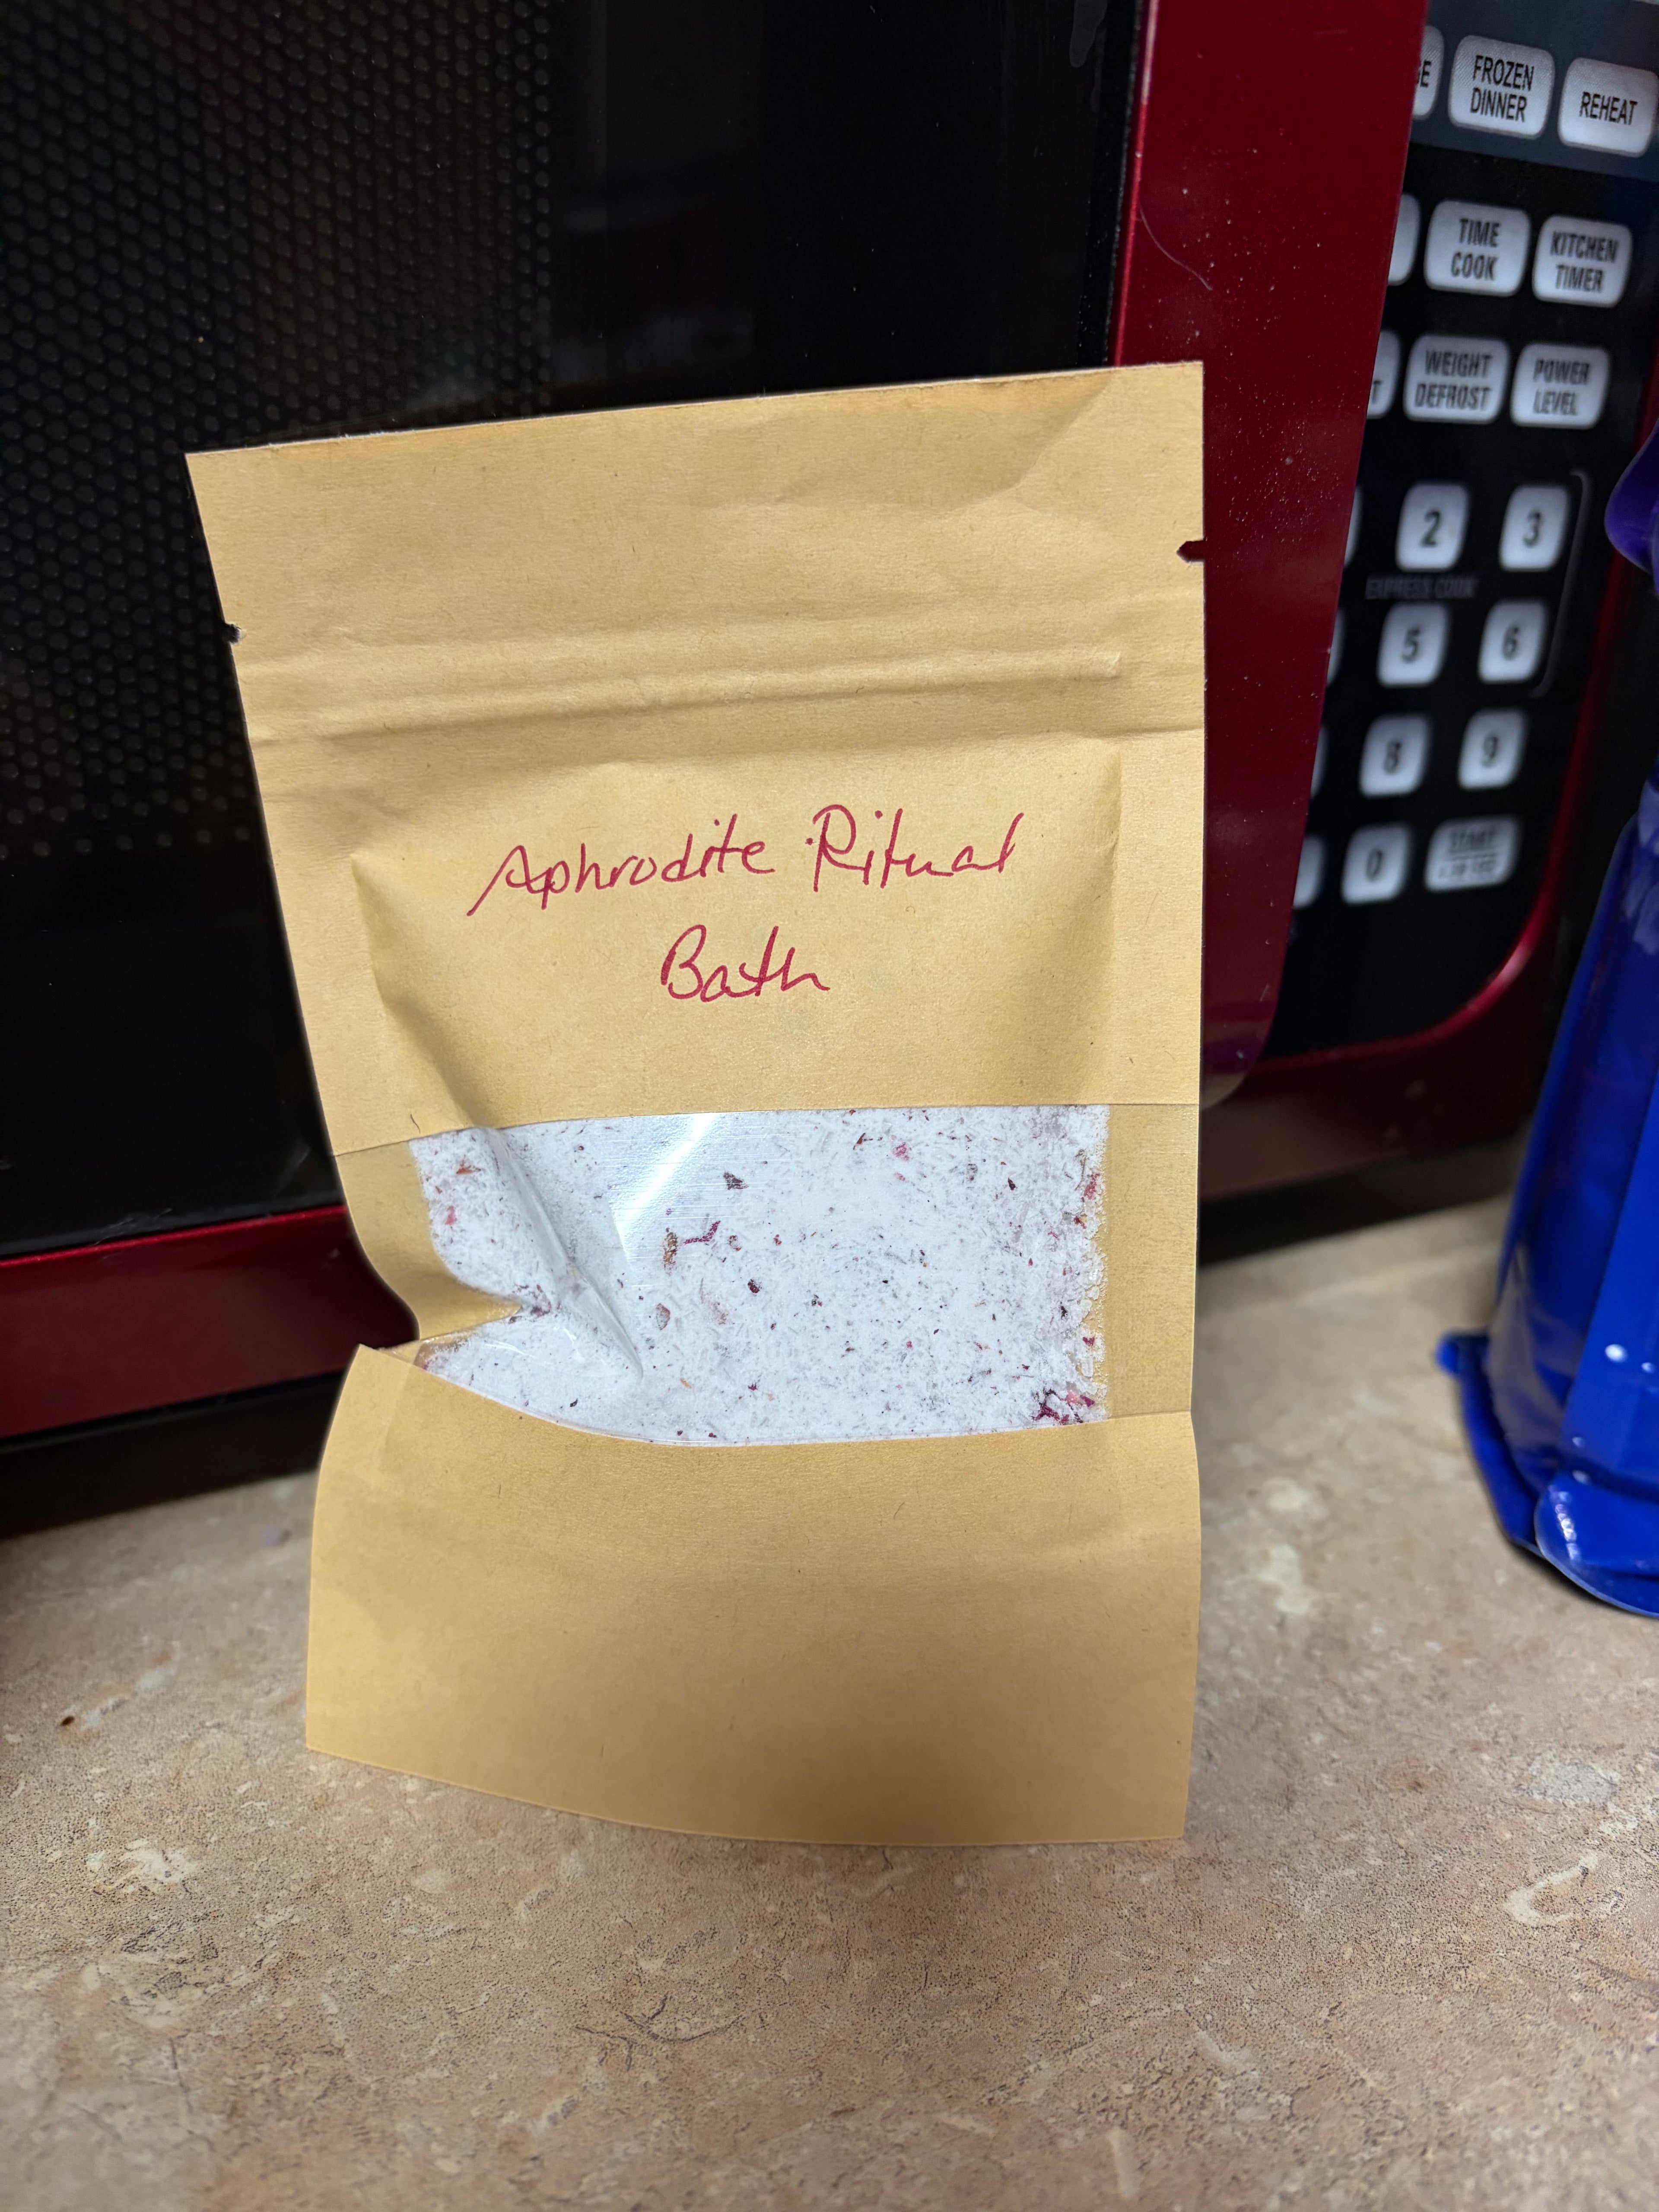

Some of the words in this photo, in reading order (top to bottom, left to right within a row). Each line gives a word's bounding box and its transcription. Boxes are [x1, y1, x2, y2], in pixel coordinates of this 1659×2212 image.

[1472, 55, 1534, 92] FROZEN
[1470, 87, 1527, 123] DINNER
[1579, 91, 1638, 125] REHEAT
[1459, 217, 1501, 248] TIME
[1550, 231, 1620, 263] KITCHEN
[1450, 251, 1498, 281] COOK
[1555, 264, 1604, 292] TIMER
[1424, 350, 1494, 378] WEIGHT
[1532, 358, 1591, 385] POWER
[1414, 382, 1493, 410] DEFROST
[1532, 389, 1577, 416] LEVEL
[1421, 509, 1442, 548] 2
[1523, 511, 1543, 549] 3
[1401, 626, 1422, 664] 5
[1503, 625, 1521, 661] 6
[1383, 739, 1403, 775] 8
[1482, 734, 1500, 769] 9
[467, 814, 774, 916] Aphrodite
[807, 804, 1023, 892] Ritual
[660, 924, 830, 1003] Bath
